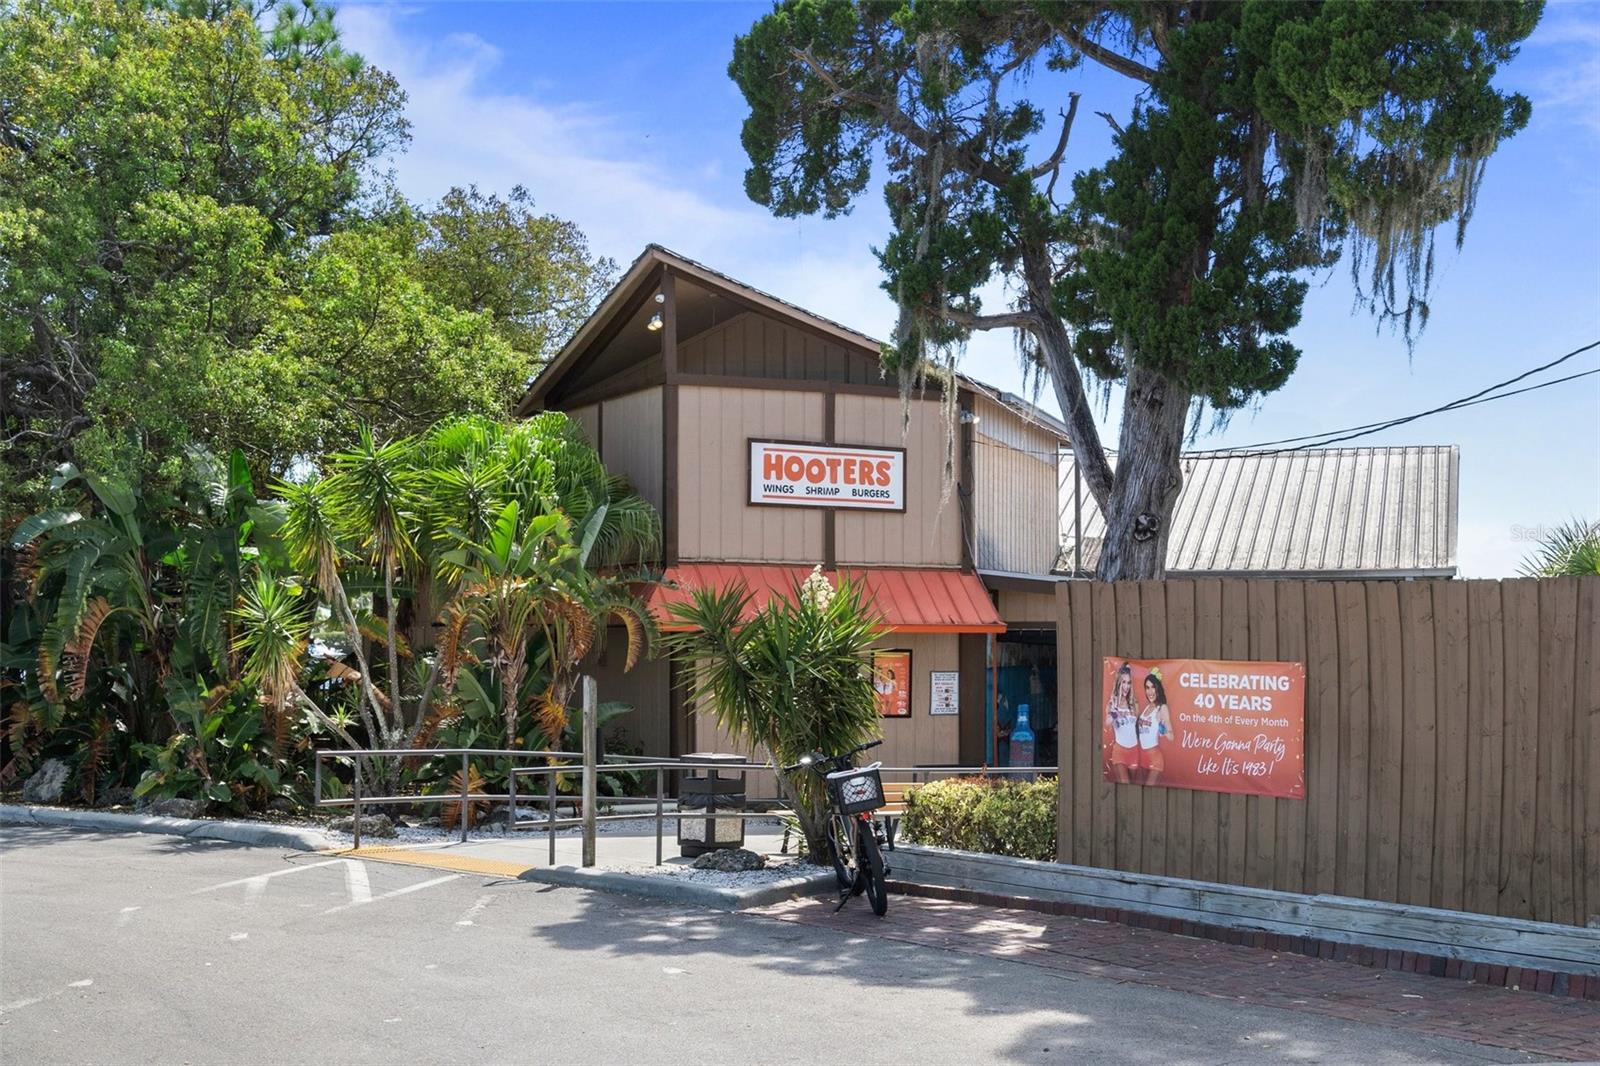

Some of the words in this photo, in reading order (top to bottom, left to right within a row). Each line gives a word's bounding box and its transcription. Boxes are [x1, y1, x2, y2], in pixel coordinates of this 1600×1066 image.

[763, 453, 891, 487] HOOTERS
[763, 484, 794, 494] WINGS
[805, 486, 840, 496] SHRIMP
[852, 488, 890, 498] BURGERS
[1179, 672, 1290, 691] CELEBRATING
[1194, 693, 1215, 709] 40
[1218, 694, 1272, 712] YEARS
[1179, 713, 1191, 722] On
[1193, 714, 1205, 723] the
[1207, 715, 1222, 724] 4th
[1224, 715, 1233, 724] of
[1235, 716, 1259, 727] Every
[1261, 717, 1289, 727] Month
[1214, 732, 1251, 755] Gonna
[1253, 733, 1286, 762] Party
[1197, 754, 1219, 775] Like
